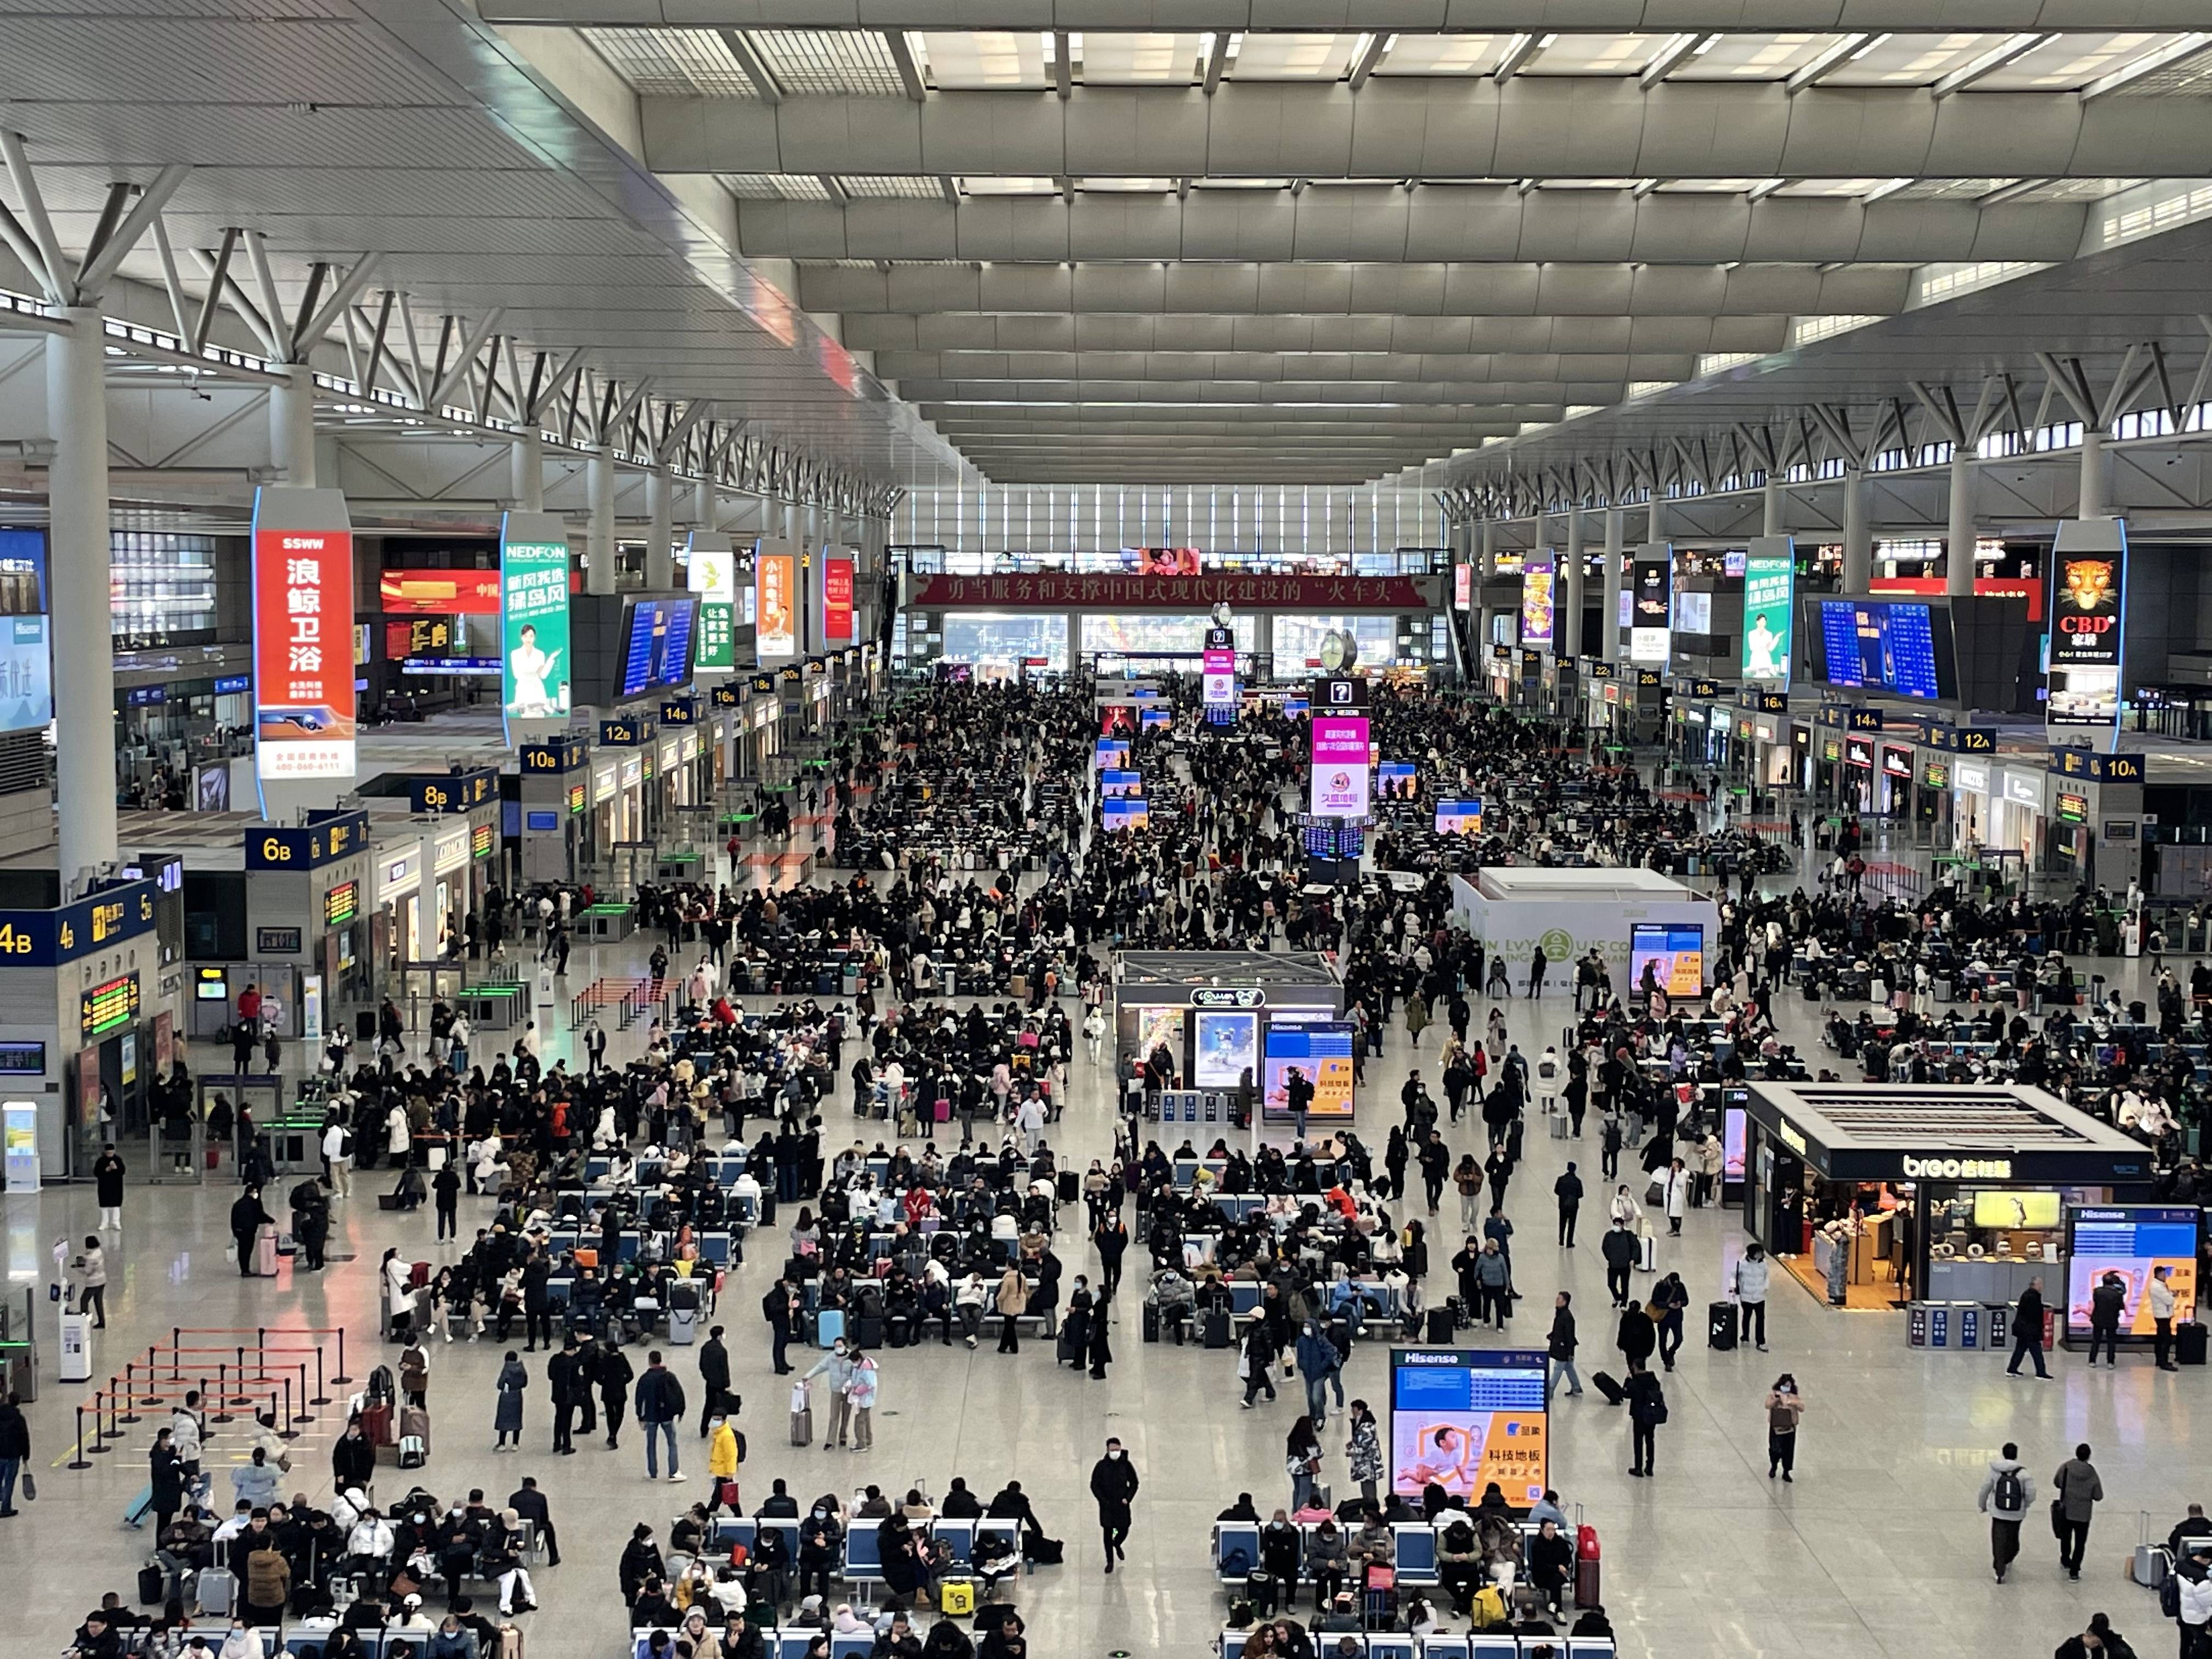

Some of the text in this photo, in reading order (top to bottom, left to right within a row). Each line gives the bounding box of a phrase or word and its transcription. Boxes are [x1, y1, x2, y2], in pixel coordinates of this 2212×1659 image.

[283, 538, 324, 550] SSWW
[506, 546, 566, 558] NEDFON
[1749, 560, 1791, 569] NEDFON
[508, 584, 566, 612] 绿岛风
[286, 558, 323, 672] 浪鲸卫浴
[2059, 616, 2111, 633] CBD
[715, 691, 735, 702] 16B
[1696, 684, 1713, 695] 18A
[1764, 697, 1783, 709] 16A
[665, 707, 688, 720] 14B
[1855, 713, 1877, 727] 14A
[606, 725, 631, 741] 12B
[1965, 734, 1990, 749] 12A
[527, 751, 556, 768] 10B
[2108, 760, 2138, 777] 10A
[425, 786, 447, 805] 8B
[263, 838, 291, 861] 6B
[0, 923, 32, 953] 4B
[1903, 1155, 1961, 1178] breo
[2081, 1210, 2125, 1219] Hisense
[1404, 1352, 1458, 1364] Hisense
[1489, 1449, 1541, 1462] 科技地板
